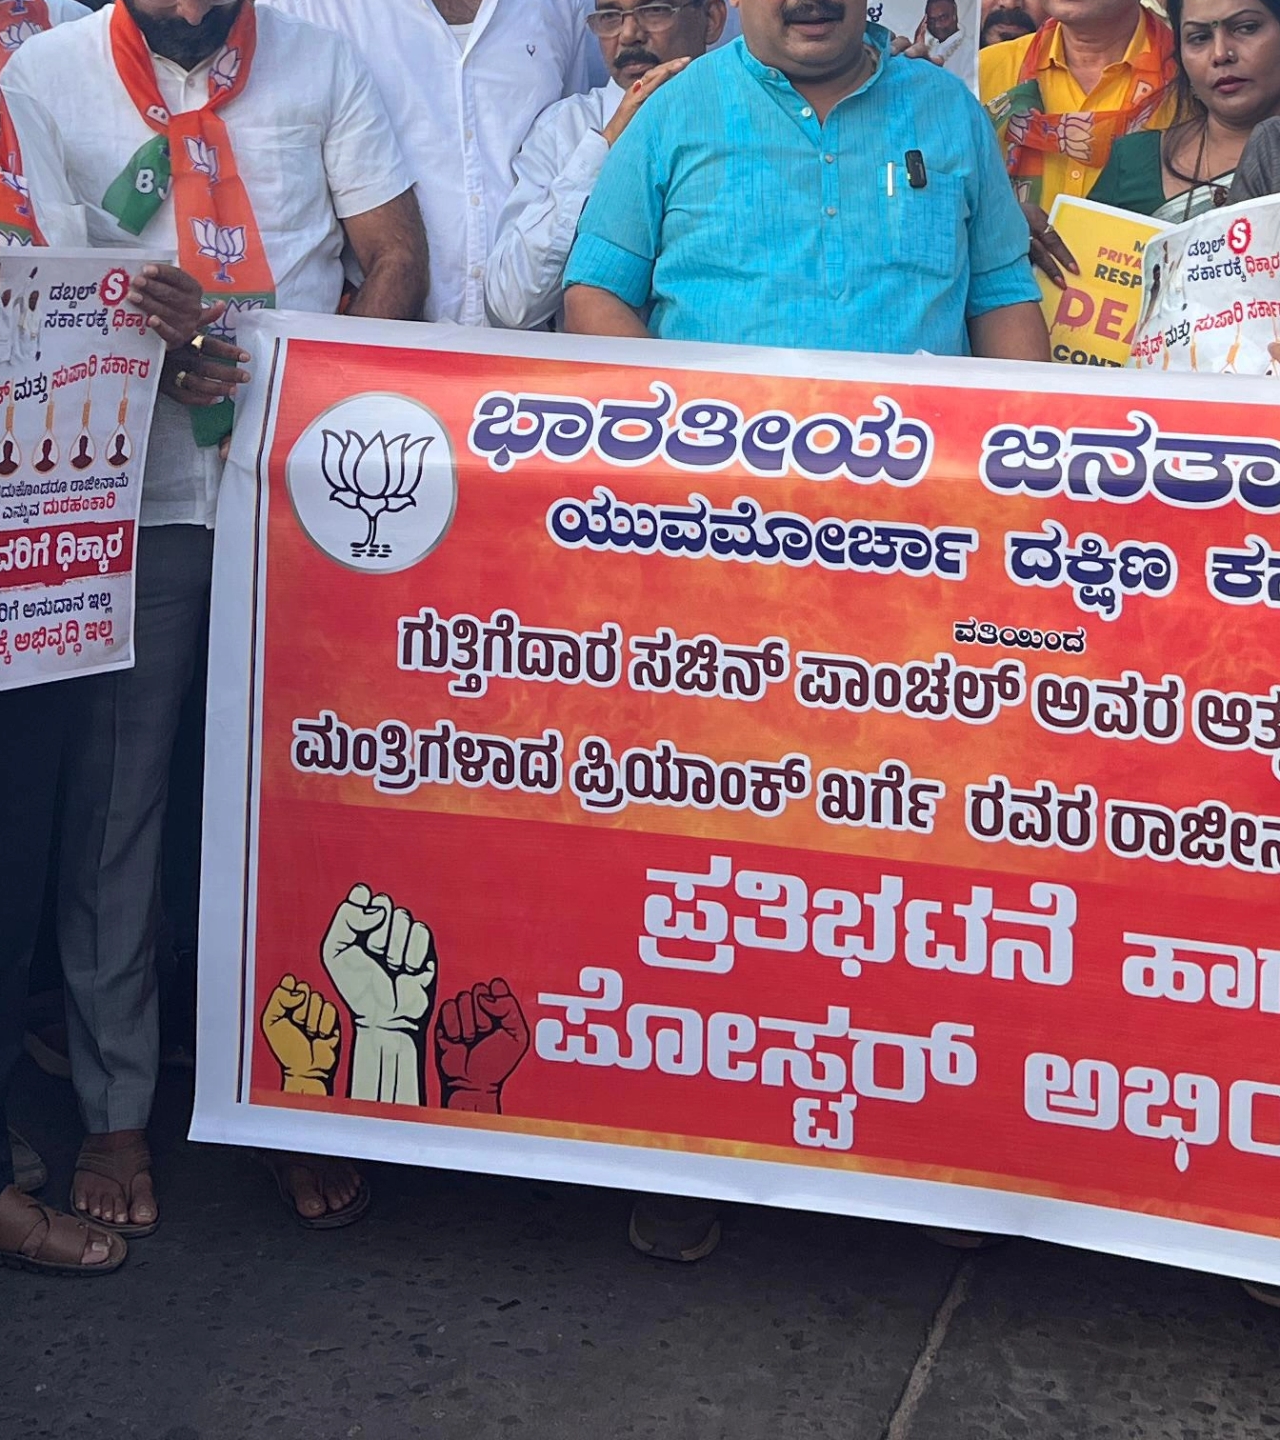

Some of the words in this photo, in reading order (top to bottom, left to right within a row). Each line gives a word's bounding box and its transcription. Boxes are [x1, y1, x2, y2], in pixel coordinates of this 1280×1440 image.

[45, 309, 109, 335] ಸರ್ಕಾರಕ್ಕೆ
[49, 282, 97, 309] ಡಬ್ಬಲ್
[51, 355, 98, 391] ಸುಪಾರಿ
[100, 354, 149, 378] ಸರ್ಕಾರ
[469, 383, 933, 486] ಭಾರತೀಯ
[55, 527, 124, 574] ಧಿಕ್ಕಾರ
[548, 487, 977, 580] ಯುವಮೋರ್ಚಾ
[1007, 522, 1173, 618] ದಕ್ಷಿಣ
[22, 593, 85, 619] ಅನುದಾನ
[954, 619, 1085, 655] ವತಿಯಿಂದ
[397, 612, 621, 698] ಗುತ್ತಿಗೆದಾರ
[629, 631, 787, 700] ಸಚಿನ್
[800, 651, 1022, 722] ಪಾಂಚಲ್
[1039, 673, 1180, 740] ಅವರ
[293, 712, 561, 795] ಮಂತ್ರಿಗಳಾದ
[572, 737, 807, 815] ಪ್ರಿಯಾಂಕ್
[818, 760, 946, 835] ಖರ್ಗೆ
[966, 778, 1097, 851] ರವರ
[637, 855, 1079, 985] ಪ್ರತಿಭಟನೆ
[537, 971, 976, 1149] ಪೋಸ್ಟರ್
